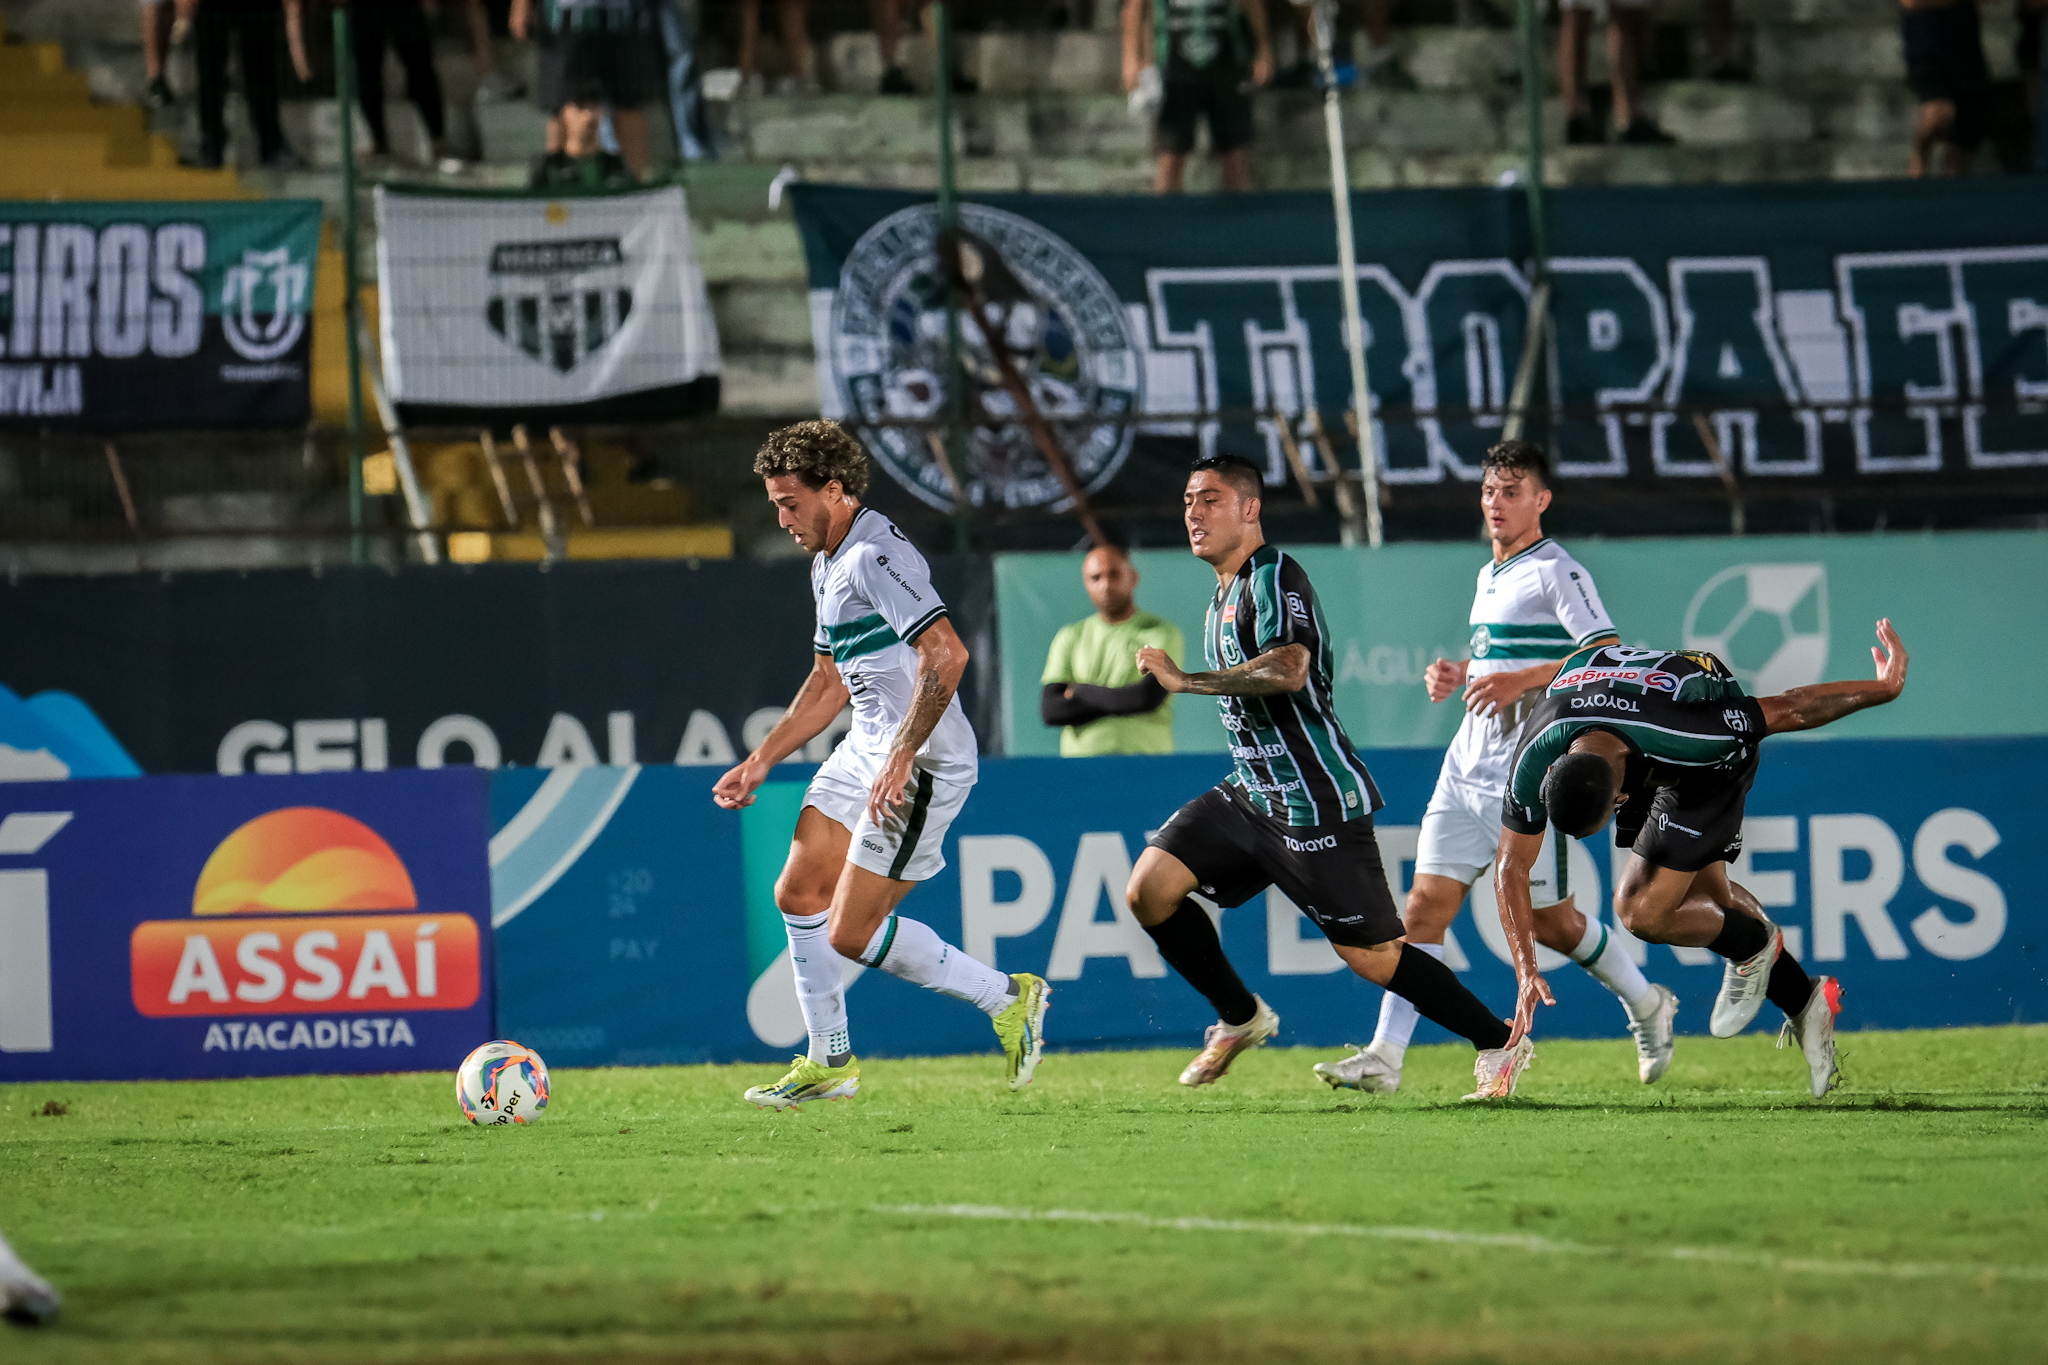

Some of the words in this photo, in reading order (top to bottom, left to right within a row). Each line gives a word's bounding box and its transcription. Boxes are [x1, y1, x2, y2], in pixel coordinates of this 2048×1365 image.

[0, 222, 206, 358] IROS
[1144, 255, 1824, 484] TROPA
[886, 565, 901, 583] vale
[900, 580, 923, 602] bonus
[860, 838, 884, 854] 1909
[168, 921, 441, 1004] ASSAÍ
[203, 1017, 415, 1053] ATACADISTA
